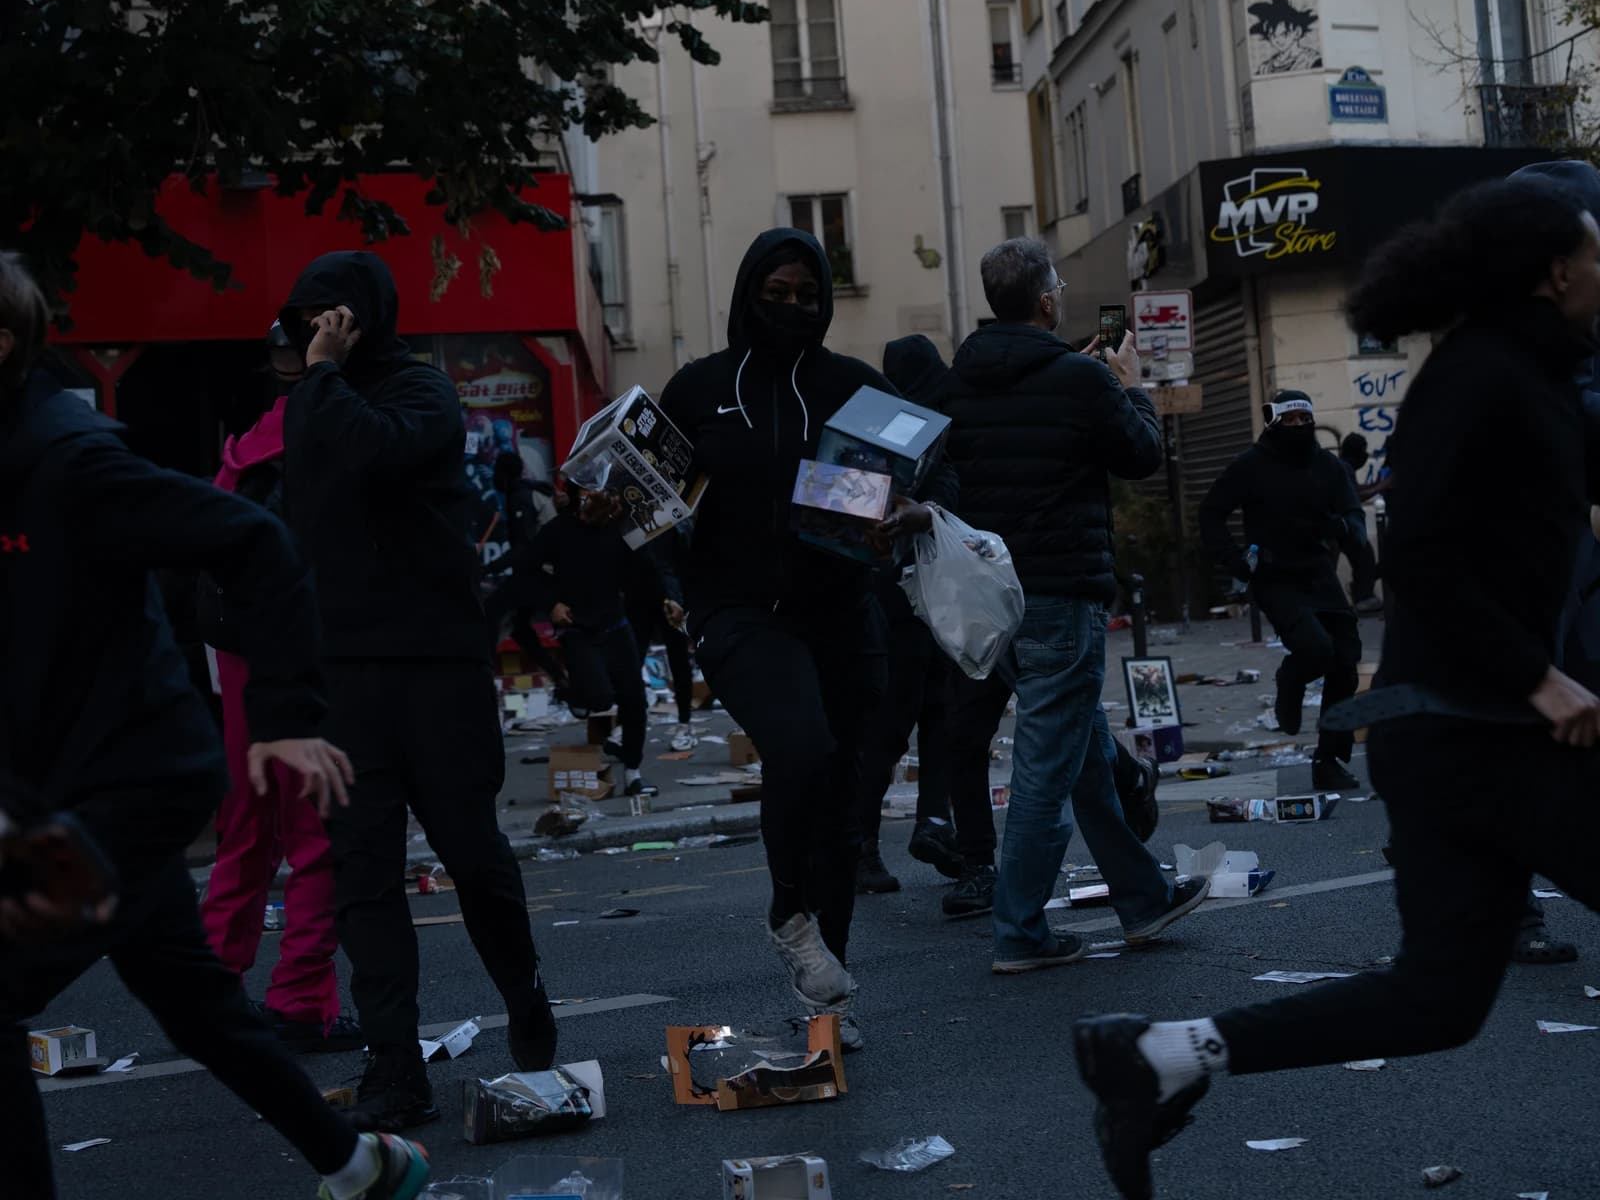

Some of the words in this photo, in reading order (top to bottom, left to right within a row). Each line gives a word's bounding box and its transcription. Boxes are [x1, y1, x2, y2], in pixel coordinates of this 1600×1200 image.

[1335, 93, 1379, 104] BOULEVARD
[1339, 104, 1378, 115] VOLTAIRE
[1218, 191, 1320, 230] MVP
[1264, 222, 1337, 260] Store
[1353, 370, 1406, 397] TOUT
